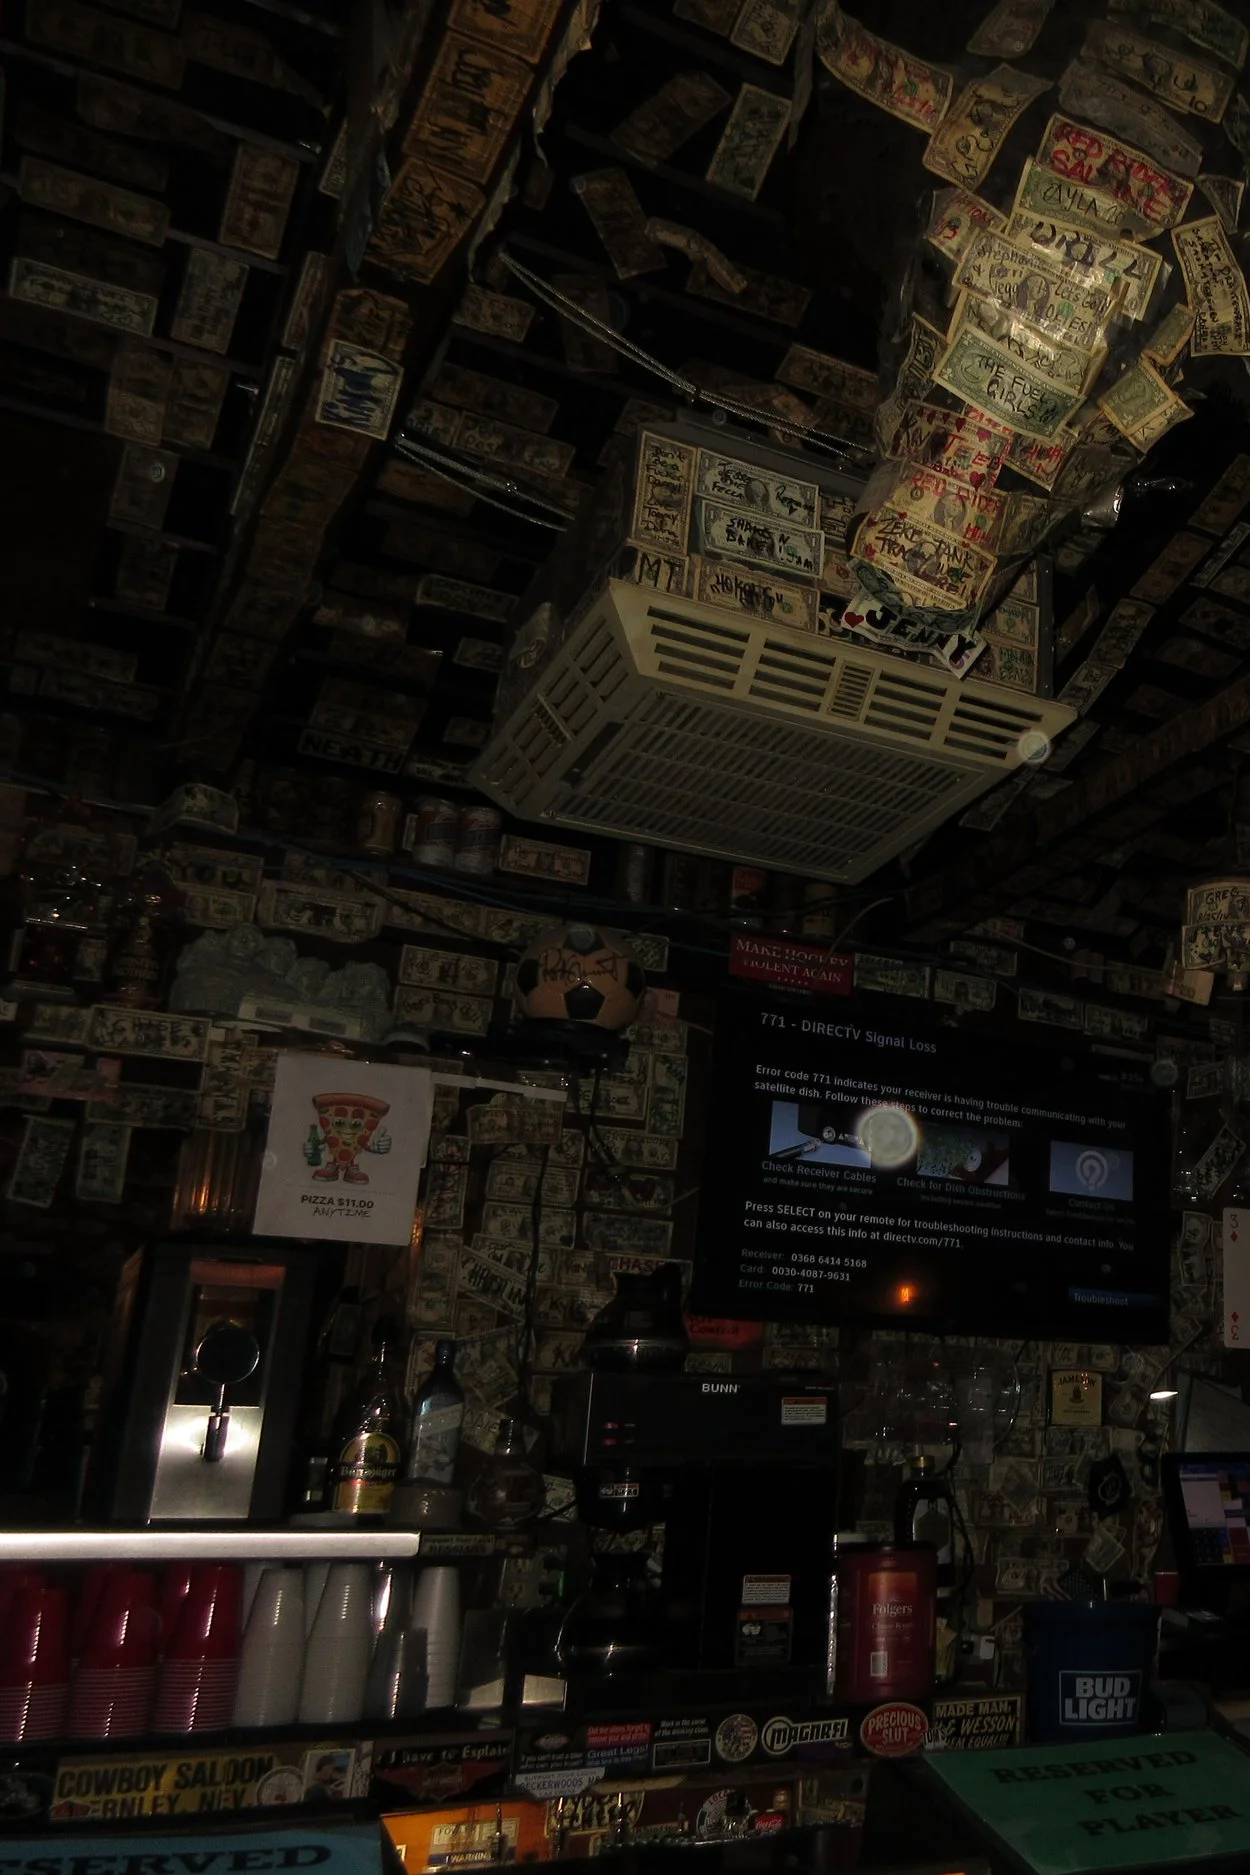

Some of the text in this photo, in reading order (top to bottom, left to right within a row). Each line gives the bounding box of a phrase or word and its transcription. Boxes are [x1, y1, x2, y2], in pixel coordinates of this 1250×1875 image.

[736, 939, 781, 959] MAKE
[744, 958, 842, 983] VIOLENT AGAIN
[760, 1012, 786, 1029] 771
[801, 1019, 861, 1040] DIRECTV
[865, 1030, 905, 1049] Signal
[909, 1037, 937, 1054] Loss
[754, 1080, 1023, 1128] satellite dish. Follow these steps to correct the problem:
[756, 1064, 781, 1077] Error
[784, 1069, 809, 1081] code
[813, 1073, 831, 1085] 771
[834, 1076, 878, 1092] indicates
[880, 1085, 902, 1096] your
[905, 1087, 942, 1101] receiver
[954, 1094, 984, 1110] having
[987, 1100, 1019, 1113] trouble
[1021, 1107, 1086, 1126] communicating
[1088, 1116, 1106, 1128] with
[1107, 1119, 1127, 1130] your
[761, 1160, 877, 1183] Check Receiver Cables
[896, 1177, 1026, 1201] Check for Dish Obstructions
[301, 1195, 374, 1209] PIZZA $11.00
[313, 1206, 370, 1218] ANYTIME
[743, 1218, 763, 1229] can
[766, 1219, 787, 1231] also
[790, 1224, 824, 1235] access
[827, 1226, 846, 1237] this
[848, 1229, 868, 1240] info
[870, 1232, 881, 1241] at
[745, 1201, 774, 1213] Press
[777, 1204, 816, 1217] SELECT
[818, 1209, 831, 1219] on
[834, 1211, 857, 1223] your
[859, 1214, 895, 1226] remote
[898, 1216, 912, 1227] for
[914, 1219, 988, 1237] troubleshooting
[991, 1227, 1044, 1242] instructions
[1045, 1232, 1062, 1243] and
[1064, 1235, 1096, 1247] contact
[1118, 1240, 1134, 1251] You
[1230, 1214, 1239, 1229] 3
[741, 1249, 868, 1269] Receiver: 0368 6414 5168
[740, 1263, 851, 1282] Card: 0030-4087-9631
[738, 1279, 764, 1289] Error
[797, 1283, 815, 1293] 771
[1074, 1293, 1129, 1306] Troubleshoot
[701, 1383, 738, 1393] BUNN
[872, 1603, 913, 1617] Folgers
[1076, 1676, 1131, 1698] BUD
[936, 1701, 975, 1717] MADE
[1065, 1697, 1136, 1720] LIGHT
[868, 1711, 922, 1735] PRECIOUS
[960, 1714, 1016, 1733] WESSON
[882, 1728, 908, 1745] SLUT
[59, 1756, 274, 1798] COWBOY SALOON
[989, 1750, 1198, 1784] RESERVED
[1083, 1782, 1175, 1805] FOR
[1077, 1804, 1244, 1837] PLAYER
